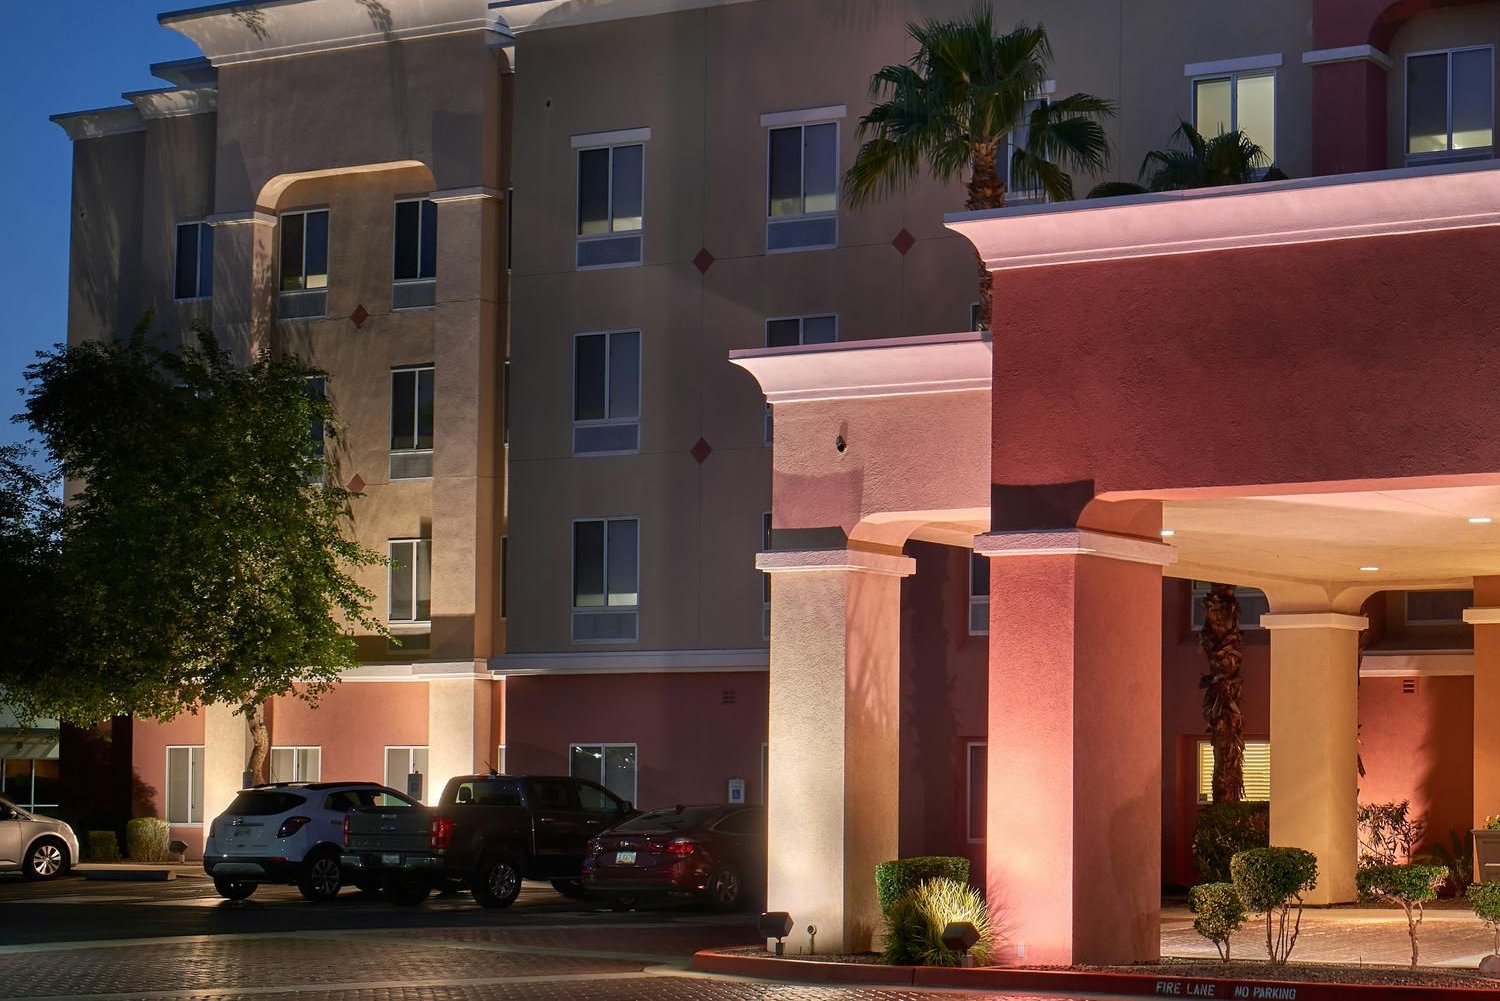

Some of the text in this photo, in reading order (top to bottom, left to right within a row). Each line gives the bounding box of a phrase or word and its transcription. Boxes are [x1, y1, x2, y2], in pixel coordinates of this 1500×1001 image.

[1156, 981, 1297, 1000] FIRE LANE NO PARKING
